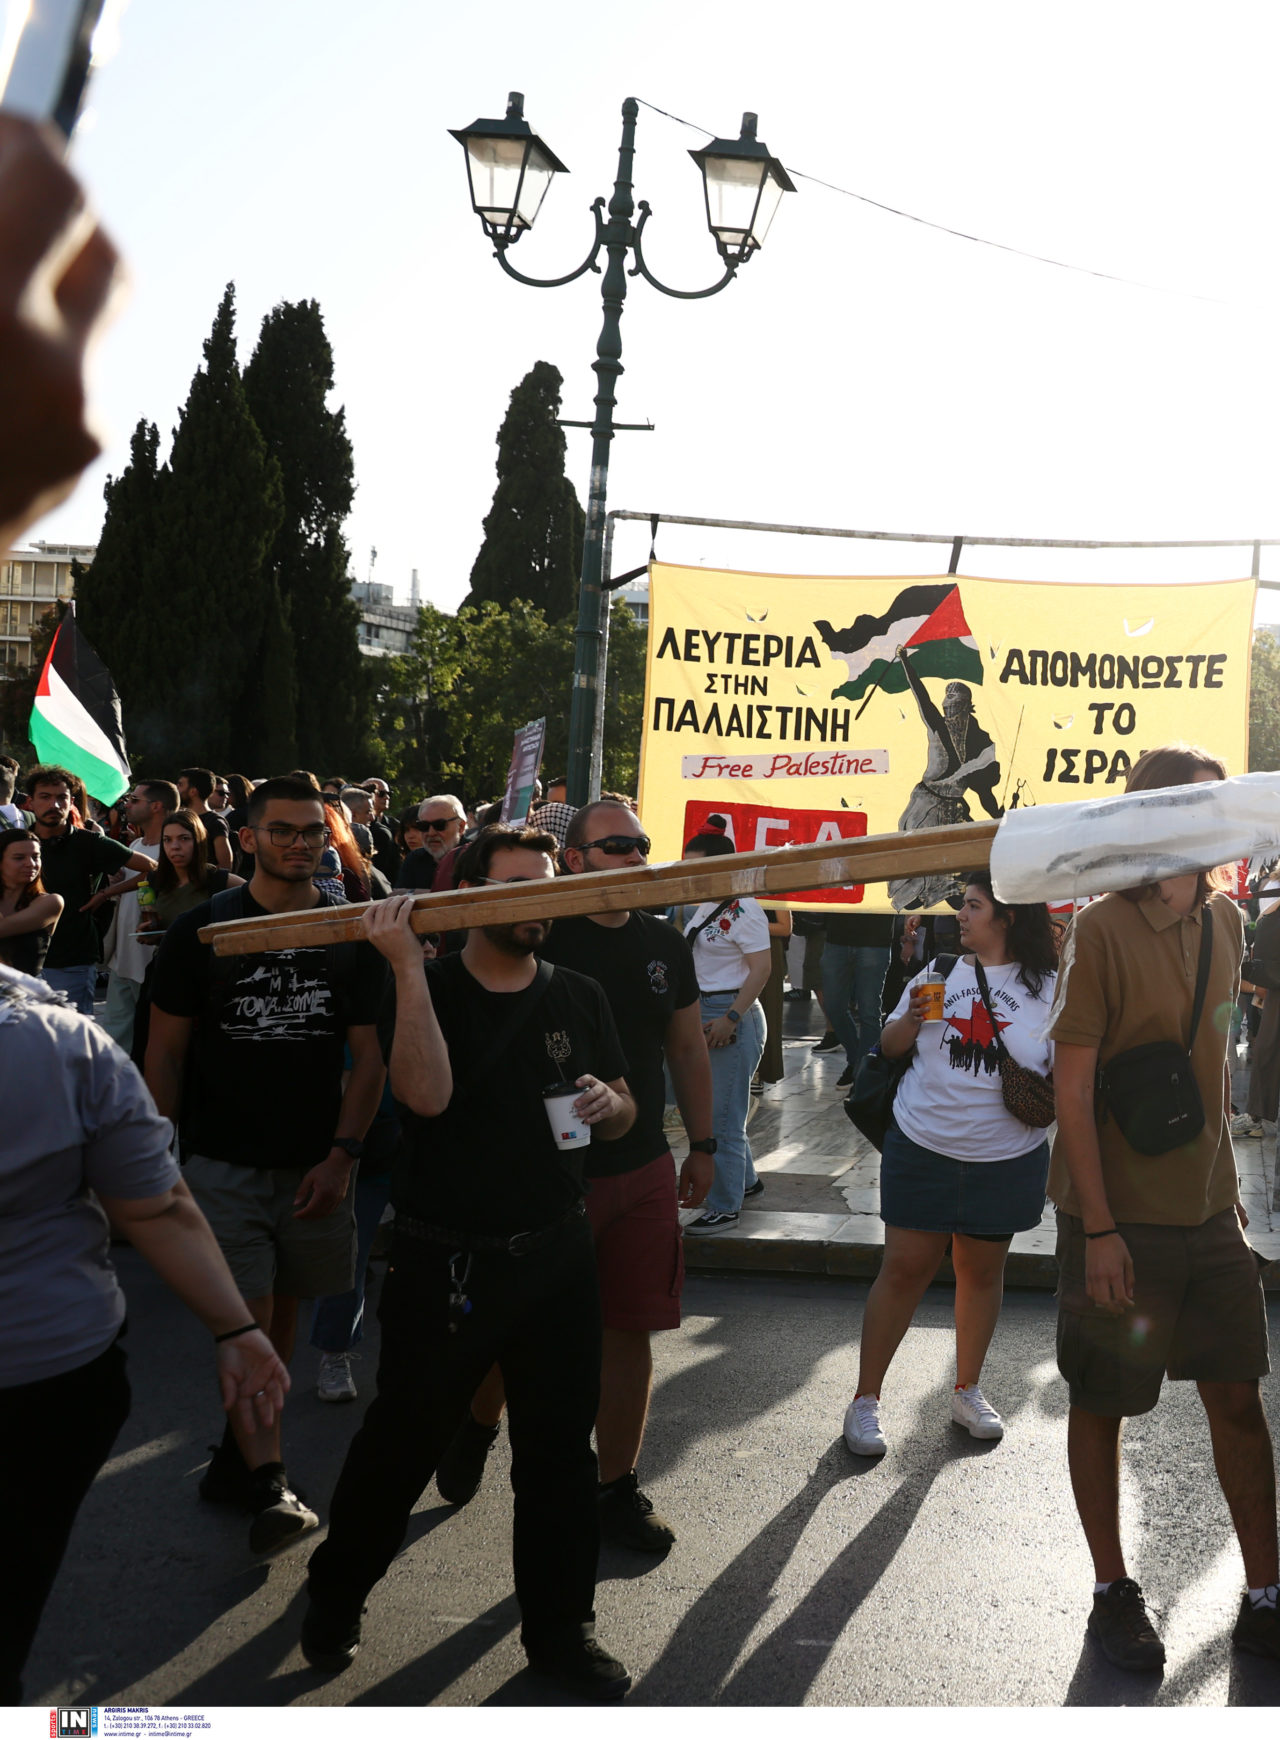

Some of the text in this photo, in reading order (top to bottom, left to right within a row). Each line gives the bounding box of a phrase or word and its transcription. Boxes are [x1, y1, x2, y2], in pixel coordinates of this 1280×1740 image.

[656, 627, 821, 668] ΛΕΥΤΕΡΙΑ
[704, 673, 768, 696] ΣΤΗΝ
[1000, 648, 1228, 689] ΑΠΟΜΟΝΩΣΤΕ
[653, 697, 850, 742] ΠΑΛΑΙΣΤΙΝΗ
[1088, 702, 1136, 735] ΤΟ
[692, 752, 877, 778] Free Palestine
[1043, 748, 1149, 784] ΙΣΡΑ
[994, 989, 1020, 1012] ATHENS
